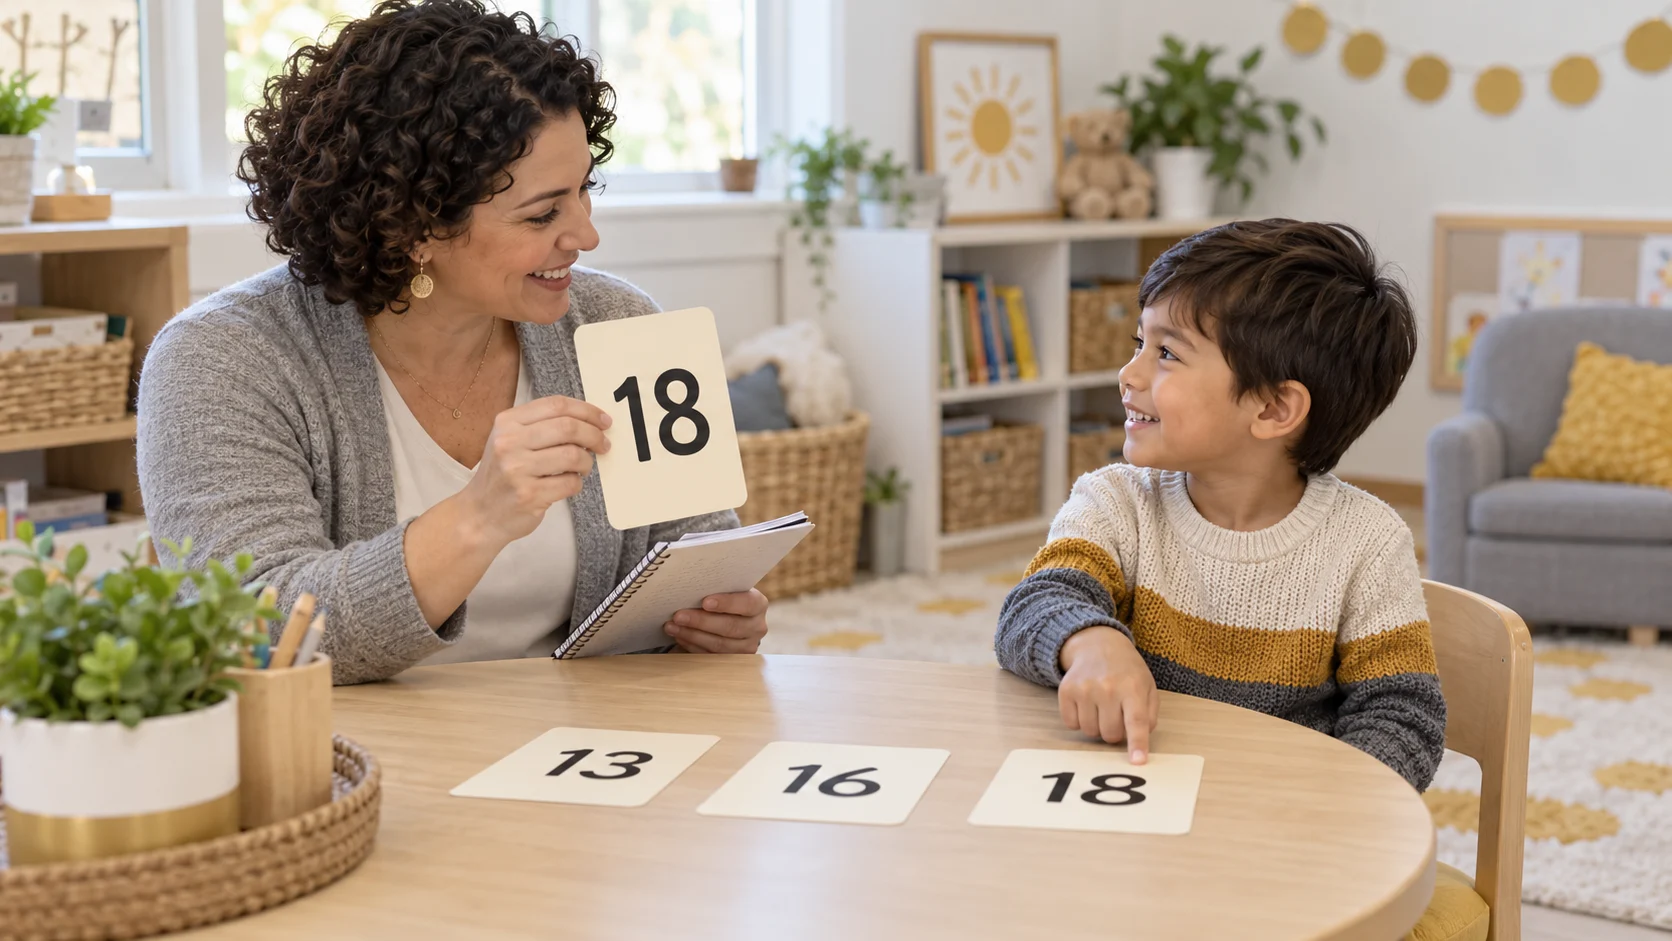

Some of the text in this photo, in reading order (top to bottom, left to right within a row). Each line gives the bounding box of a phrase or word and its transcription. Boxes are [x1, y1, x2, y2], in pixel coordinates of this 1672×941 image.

[613, 368, 710, 463] 18
[545, 748, 654, 780] 13
[783, 764, 881, 797] 16
[1041, 772, 1147, 806] 18
